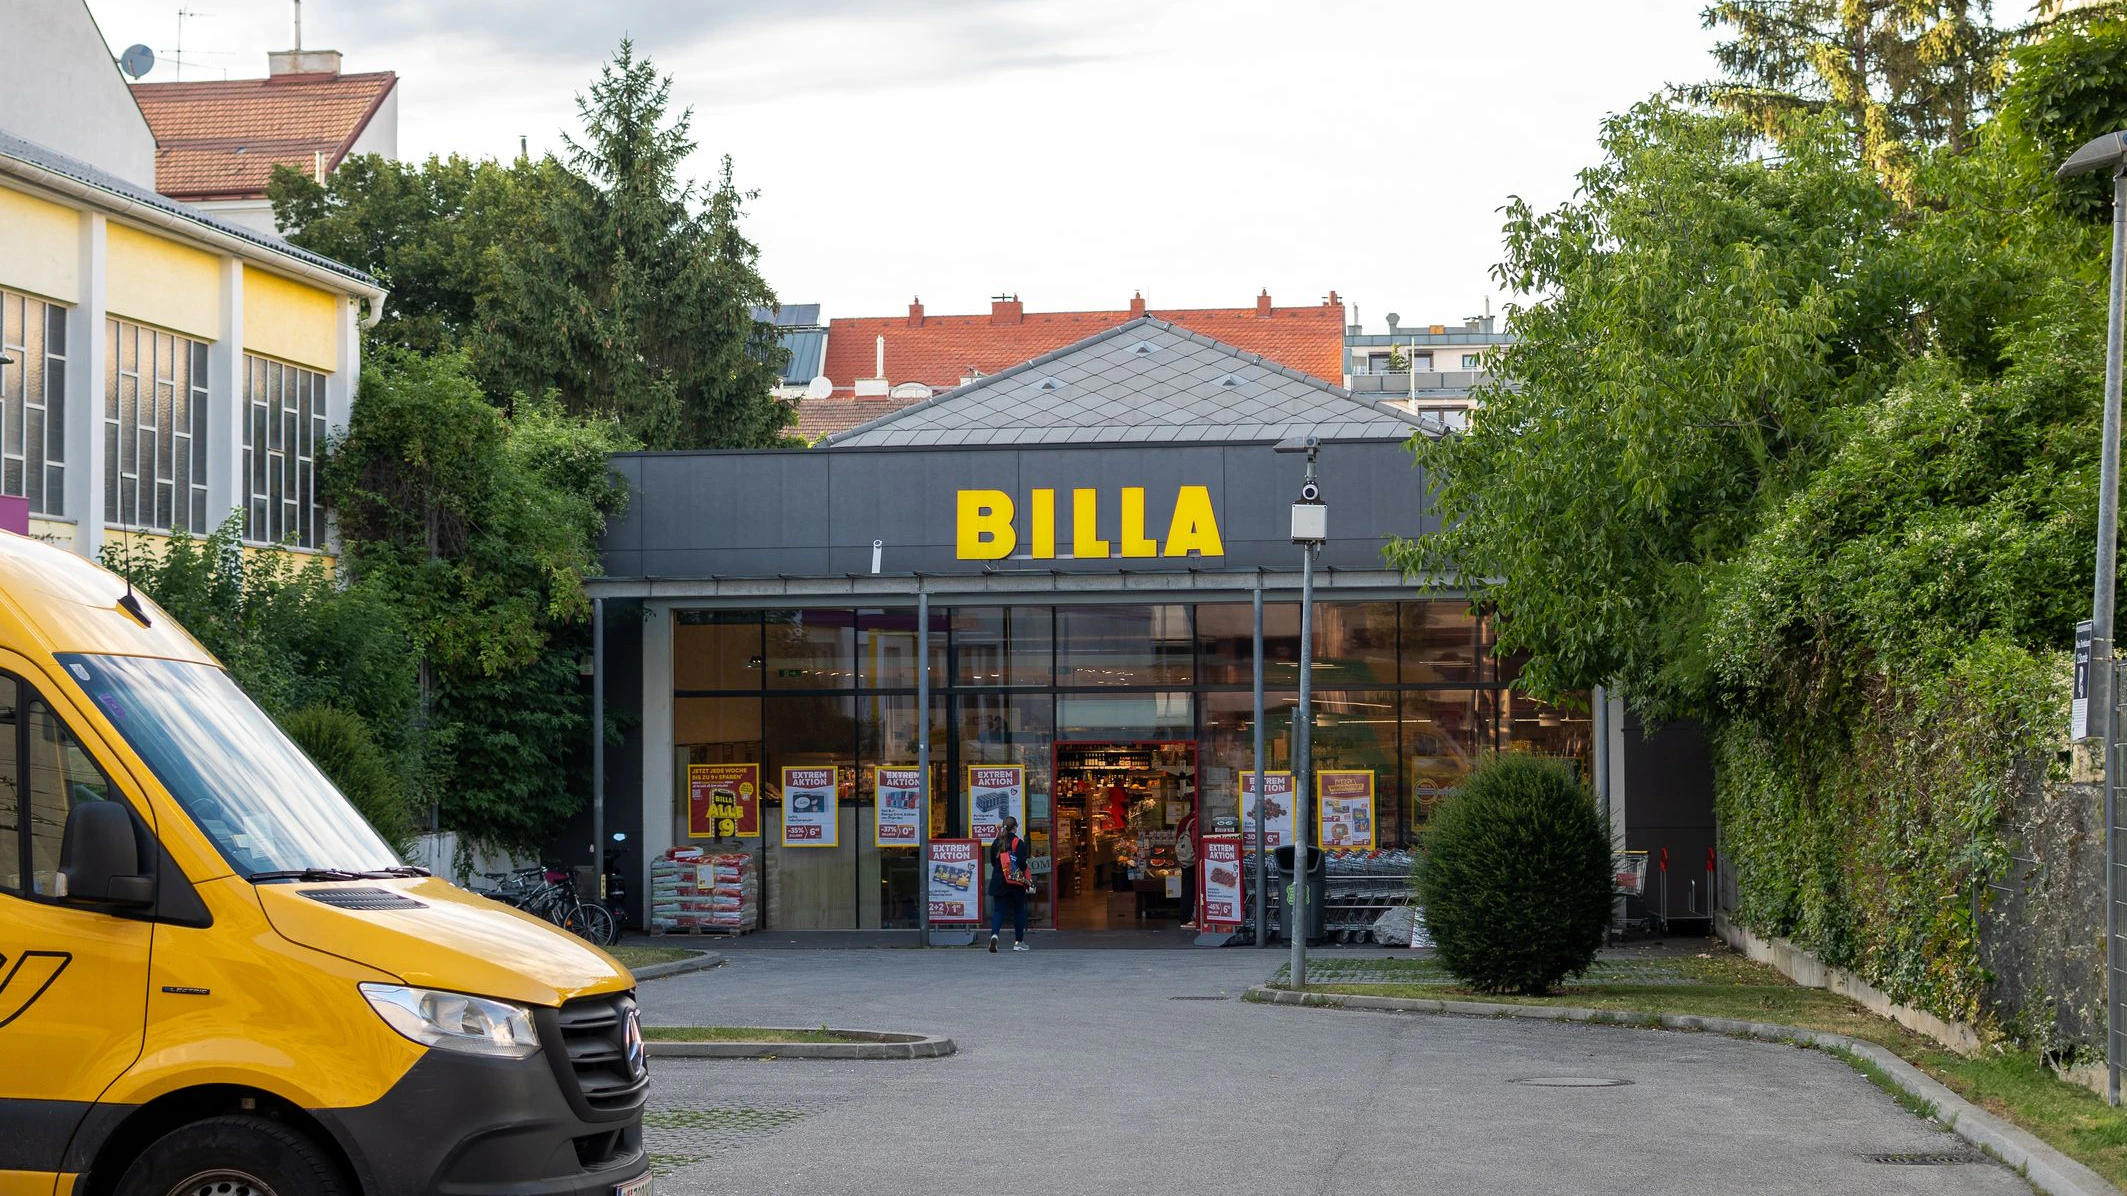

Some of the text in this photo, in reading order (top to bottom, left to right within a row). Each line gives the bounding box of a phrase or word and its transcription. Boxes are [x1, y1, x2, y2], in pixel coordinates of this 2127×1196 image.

[956, 485, 1225, 560] BILLA
[792, 771, 827, 779] EXTREM
[793, 778, 827, 786] AKTION
[887, 778, 920, 786] AKTION
[978, 778, 1013, 786] AKTION
[1249, 777, 1285, 785] EREM
[707, 803, 744, 818] ALLE
[718, 819, 735, 837] 9
[933, 844, 970, 852] EXTREM
[1209, 844, 1234, 852] EXTREM
[933, 852, 970, 860] AKTION
[1209, 852, 1235, 860] AKTION
[929, 903, 944, 911] 2+2
